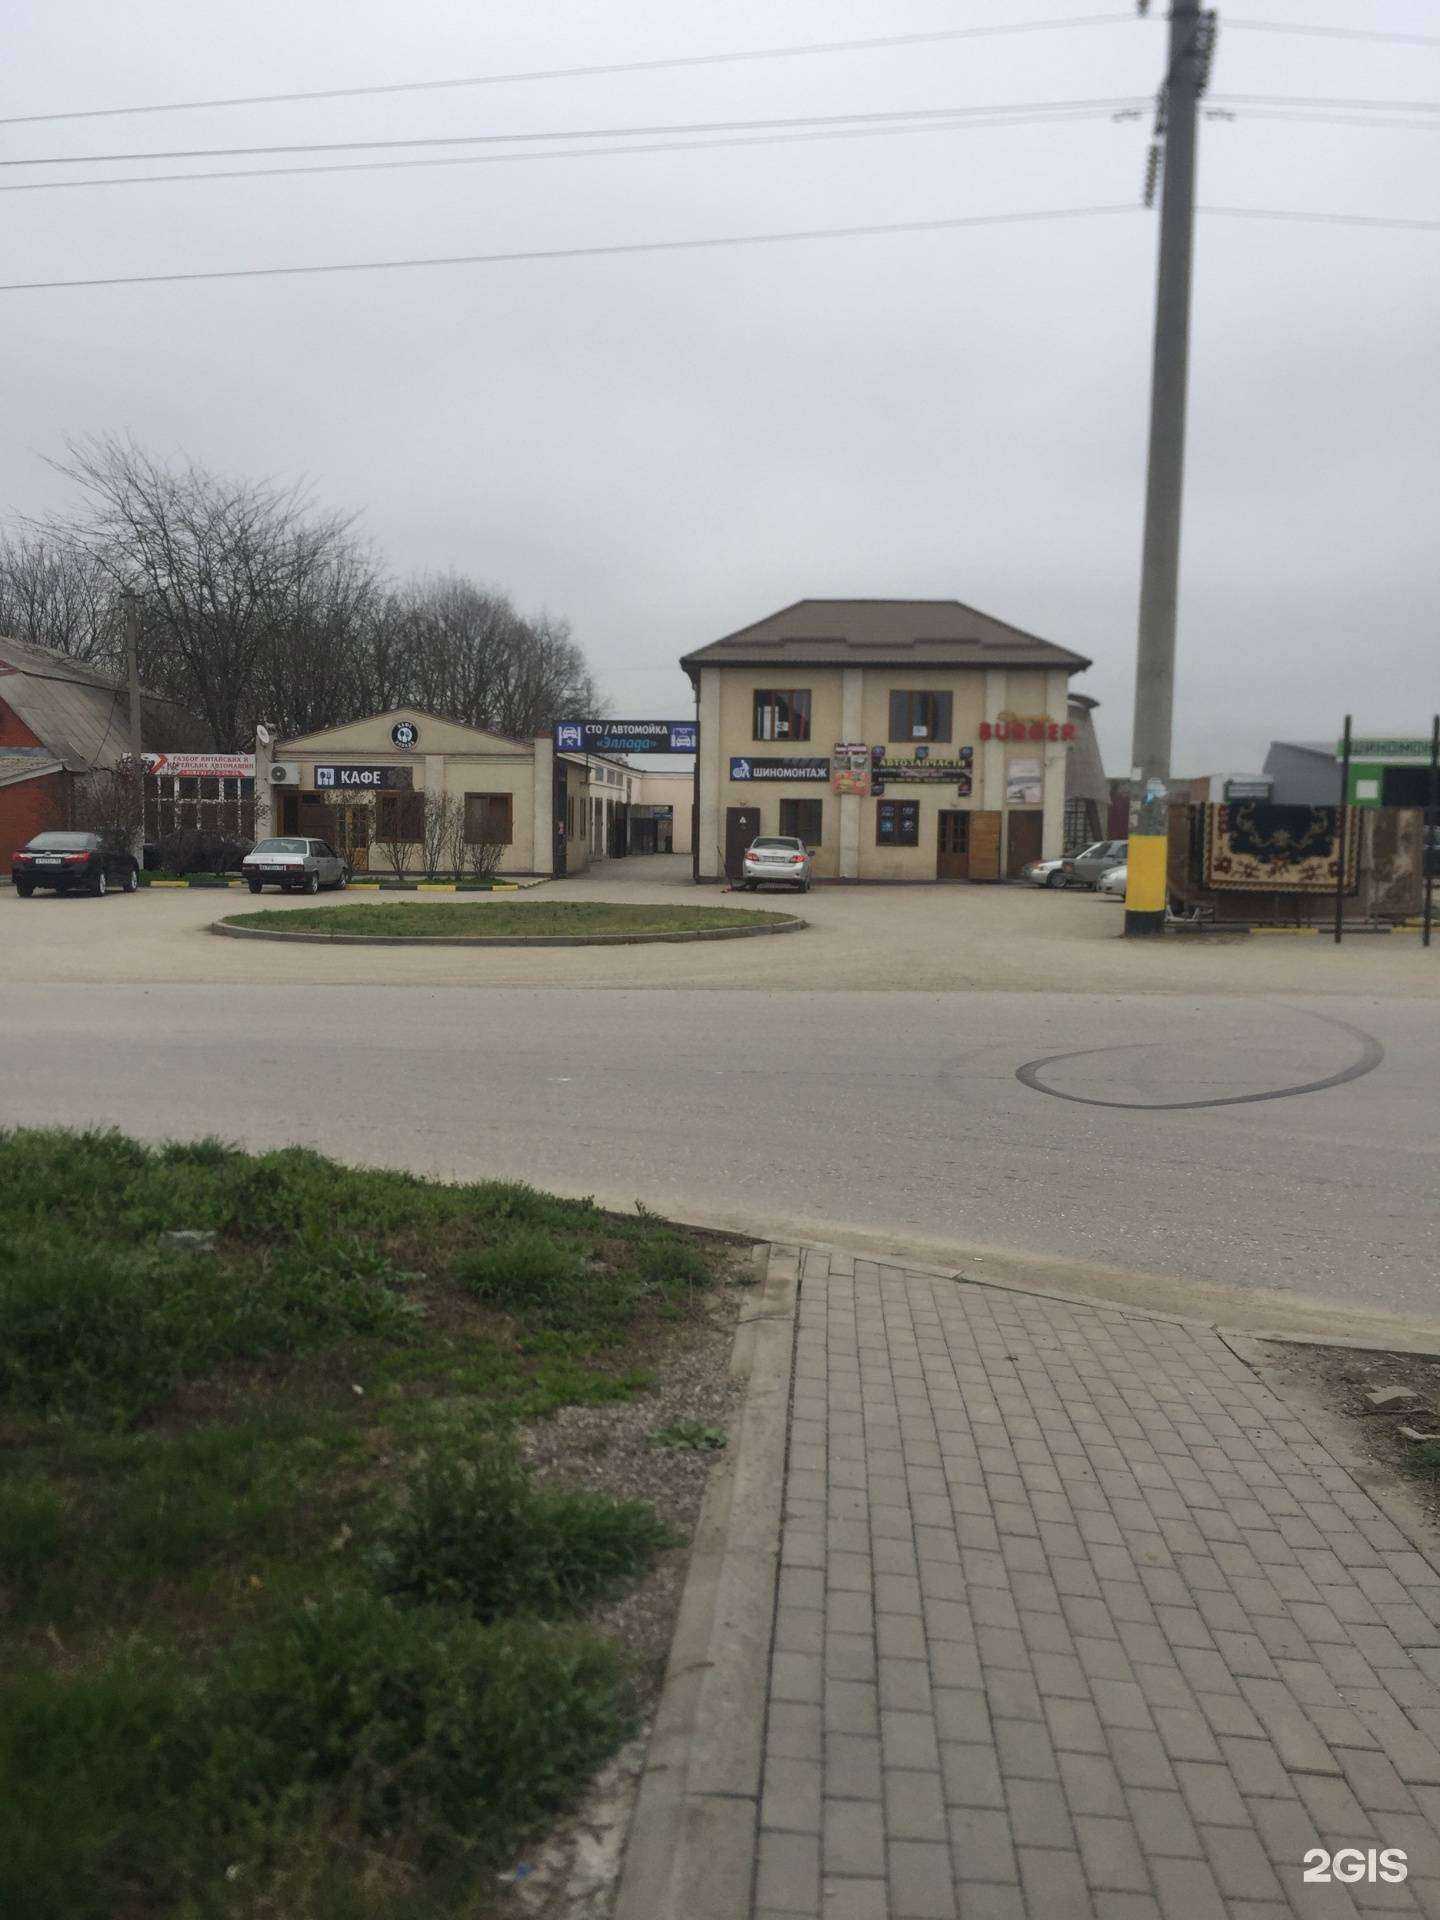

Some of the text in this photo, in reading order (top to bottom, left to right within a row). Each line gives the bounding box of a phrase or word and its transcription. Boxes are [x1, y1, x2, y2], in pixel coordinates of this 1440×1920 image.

[585, 724, 602, 735] СТО
[611, 723, 668, 735] АВТОМОЙКА
[979, 721, 1077, 742] BURGER
[210, 762, 254, 770] АВТОМАШИН
[879, 758, 965, 768] АВТОЗАПЧАСТИ
[341, 770, 382, 784] КАФЕ
[753, 765, 827, 778] ШИНОМОНТАЖ
